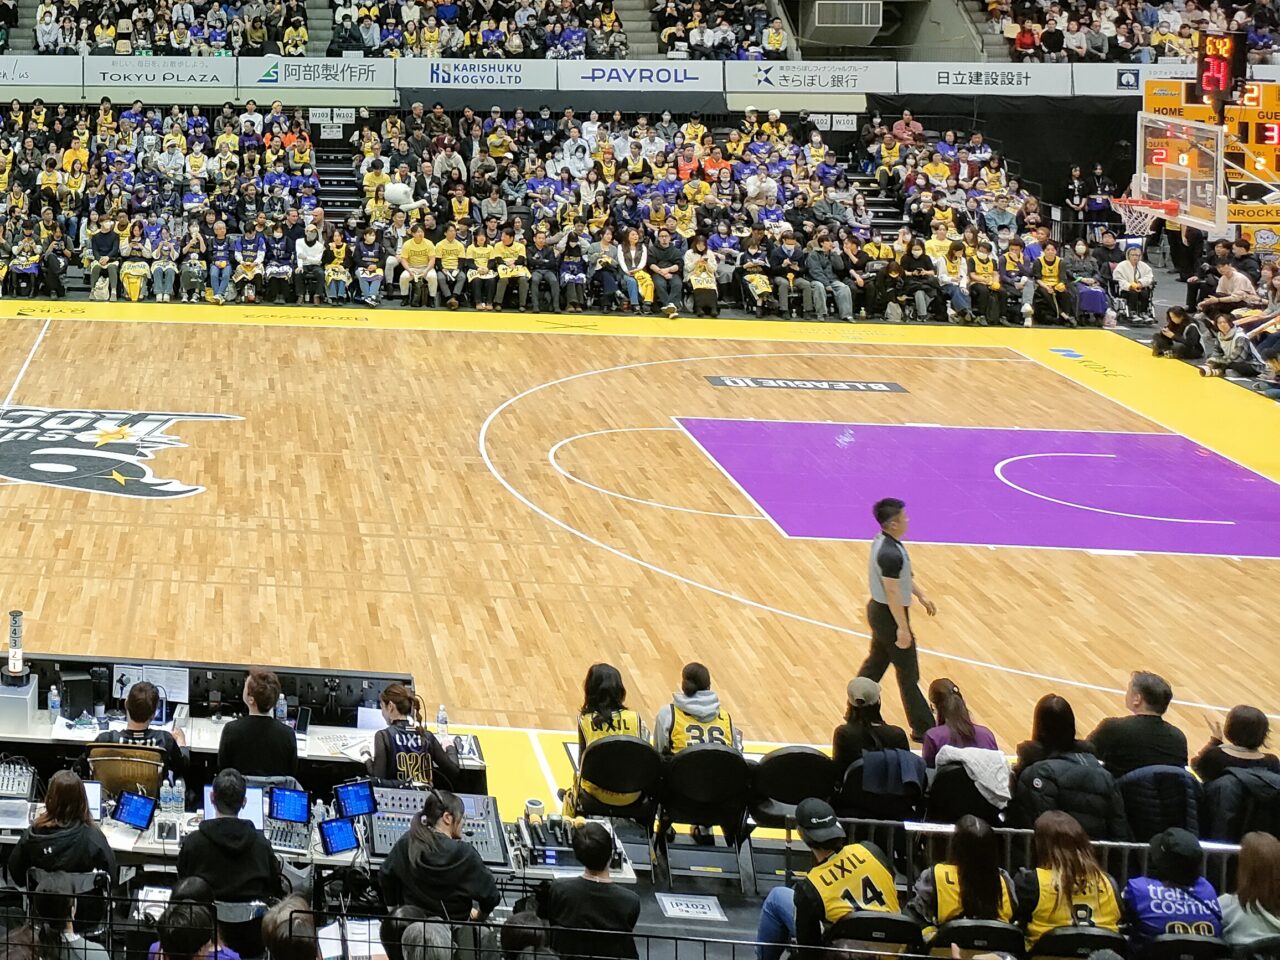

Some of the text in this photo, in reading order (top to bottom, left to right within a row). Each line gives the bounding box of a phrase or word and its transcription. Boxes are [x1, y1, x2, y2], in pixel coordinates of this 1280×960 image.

[1206, 36, 1230, 57] 6:42
[284, 63, 376, 82] 阿部製作所
[453, 63, 522, 73] KARISHUKU
[581, 68, 699, 83] PAYROLL
[1202, 57, 1228, 91] 24
[453, 75, 522, 85] KOGYO.LTD
[778, 74, 858, 88] きらぼし銀行
[937, 71, 1032, 87] 日立建設設計
[1153, 106, 1184, 117] HOME
[757, 379, 893, 391] B.LEAGUE
[590, 719, 630, 733] LIXIL
[395, 733, 423, 748] LIXI
[685, 724, 726, 746] 36
[819, 853, 866, 887] LIXIL
[840, 874, 887, 912] 14
